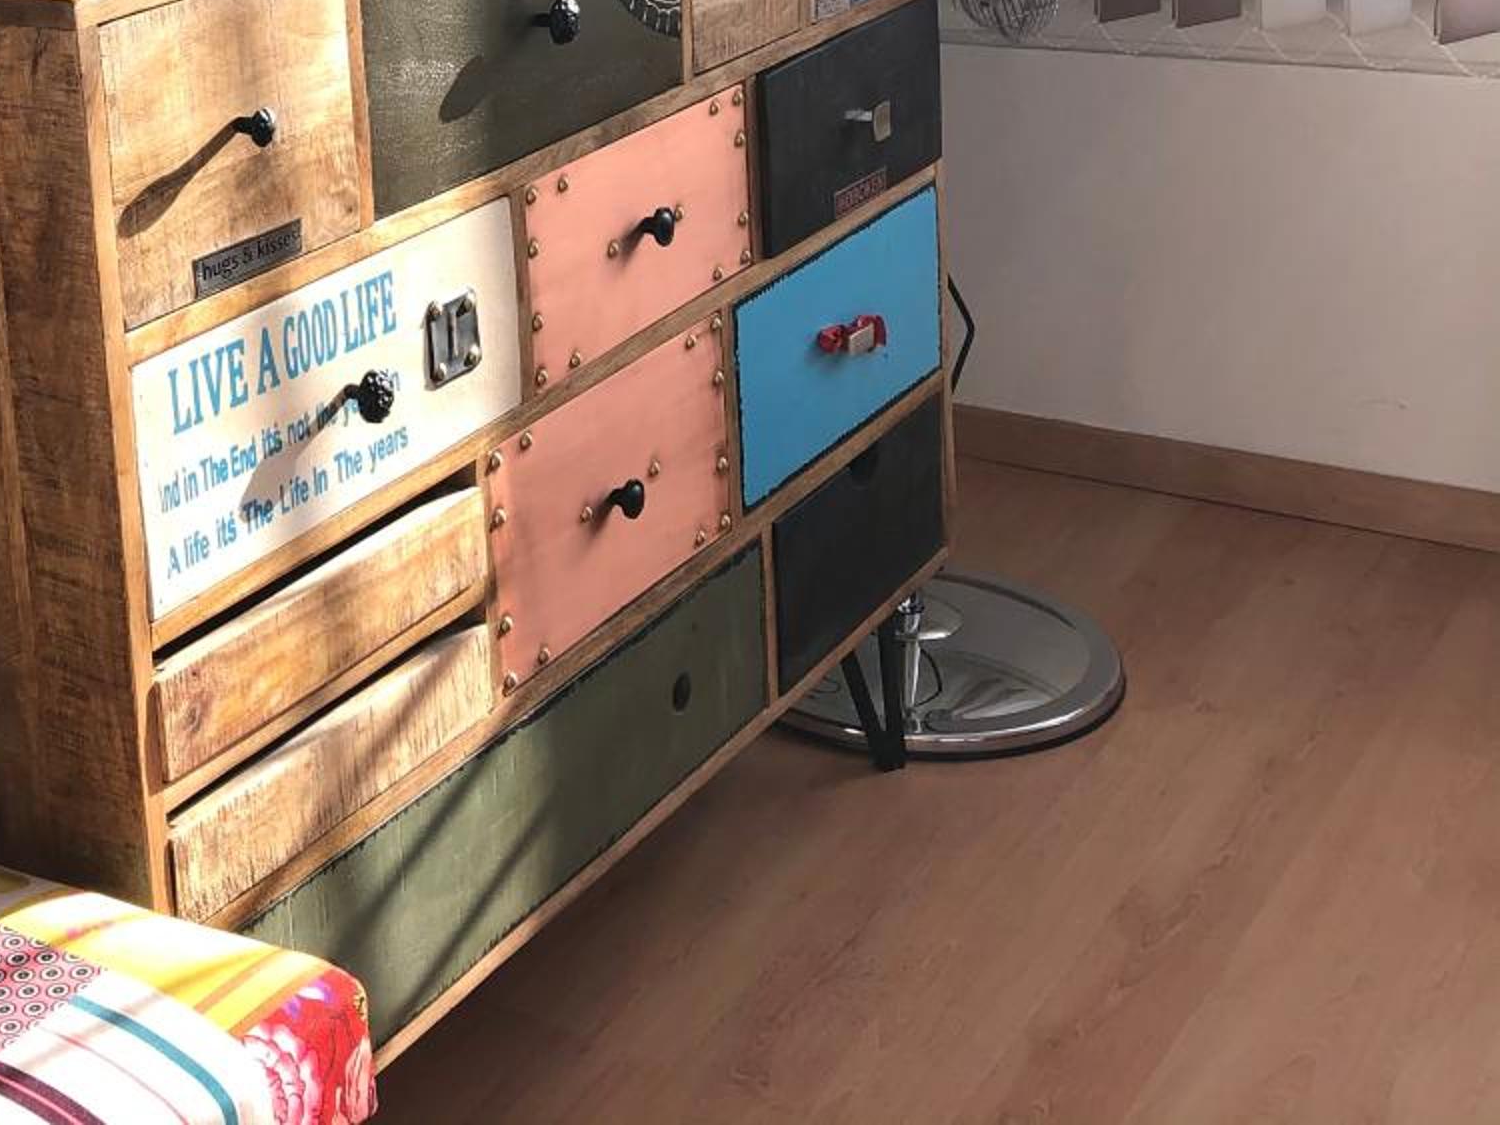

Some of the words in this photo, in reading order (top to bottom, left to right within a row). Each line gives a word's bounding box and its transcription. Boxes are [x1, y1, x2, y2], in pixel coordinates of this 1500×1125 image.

[202, 254, 239, 281] hugs
[242, 246, 253, 265] &
[167, 338, 249, 435] LIVE
[257, 326, 282, 395] A
[283, 297, 337, 378] GOOD
[341, 271, 397, 354] LIFE
[167, 544, 182, 580] A
[183, 530, 210, 567] life
[242, 497, 274, 535] The
[279, 480, 310, 515] Life
[313, 466, 329, 496] In
[333, 450, 364, 484] The
[367, 426, 409, 474] years
[182, 466, 199, 503] in
[200, 455, 228, 491] The
[229, 435, 257, 478] End
[287, 411, 311, 445] not
